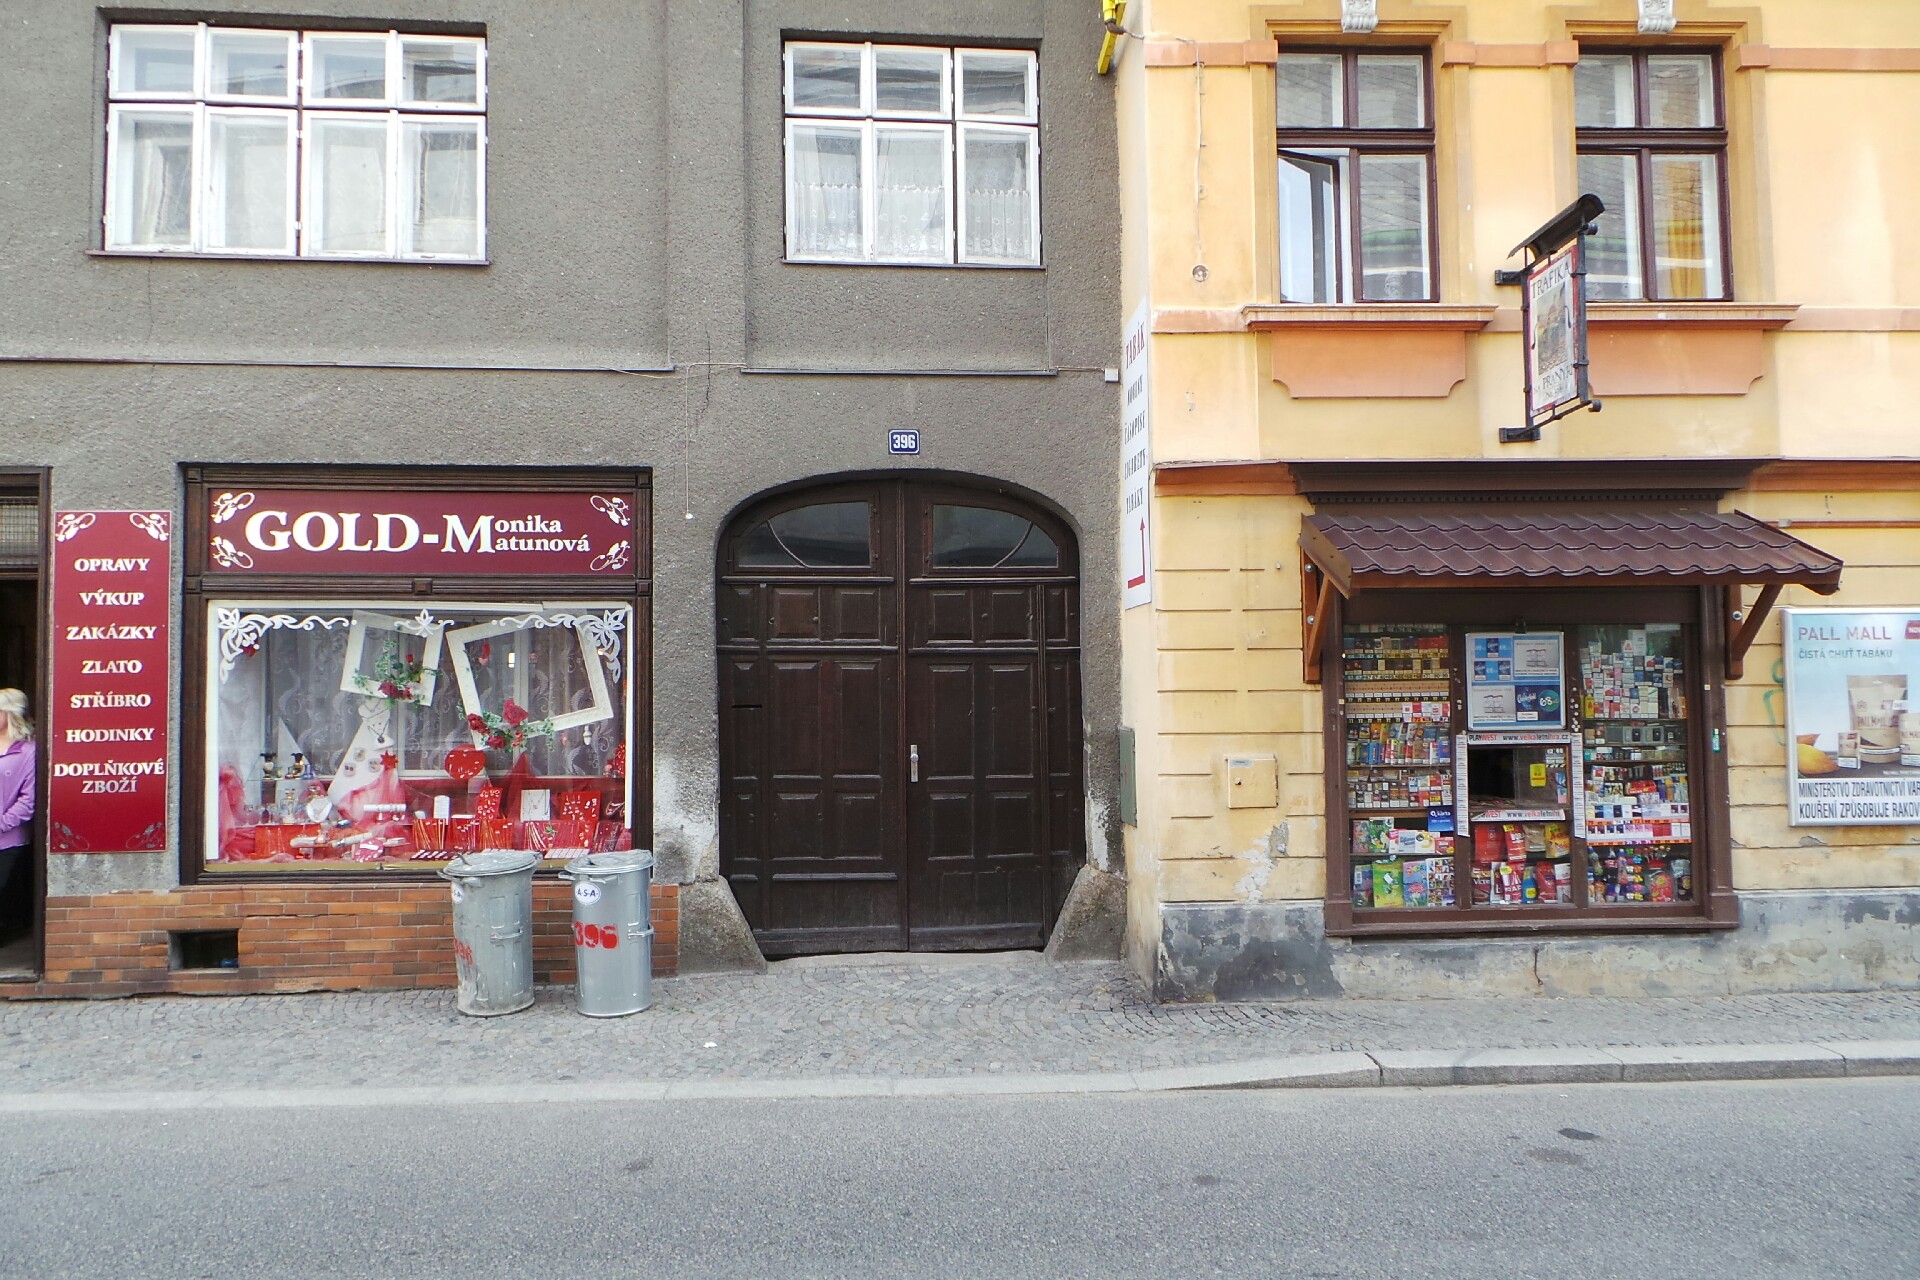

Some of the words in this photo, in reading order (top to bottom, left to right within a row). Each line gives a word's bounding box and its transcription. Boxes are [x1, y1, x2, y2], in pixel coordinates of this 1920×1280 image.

[1532, 261, 1571, 299] TRAFIKA
[1126, 321, 1145, 370] TABÁK
[893, 434, 916, 449] 396
[74, 558, 151, 572] OPRAVY
[79, 588, 145, 606] VÝKUP
[66, 623, 157, 641] ZAKÁZKY
[1798, 626, 1841, 641] PALL
[1845, 625, 1893, 641] MALL
[1798, 647, 1826, 659] ČISTÁ
[1829, 647, 1854, 659] CHUŤ
[1856, 647, 1893, 658] TABÁKU
[81, 659, 143, 674] ZLATO
[70, 691, 152, 709] STŘÍBRO
[65, 727, 155, 743] HODINKY
[53, 757, 165, 777] DOPLŇKOVÉ
[81, 776, 138, 794] ZBOŽÍ
[1798, 782, 1850, 798] MINISTERSTVO
[1852, 778, 1906, 797] ZDRAVOTNICTVÍ
[1799, 800, 1838, 819] KOUŘENÍ
[1840, 799, 1890, 819] ZPŮSOBUJE
[574, 920, 619, 950] 396
